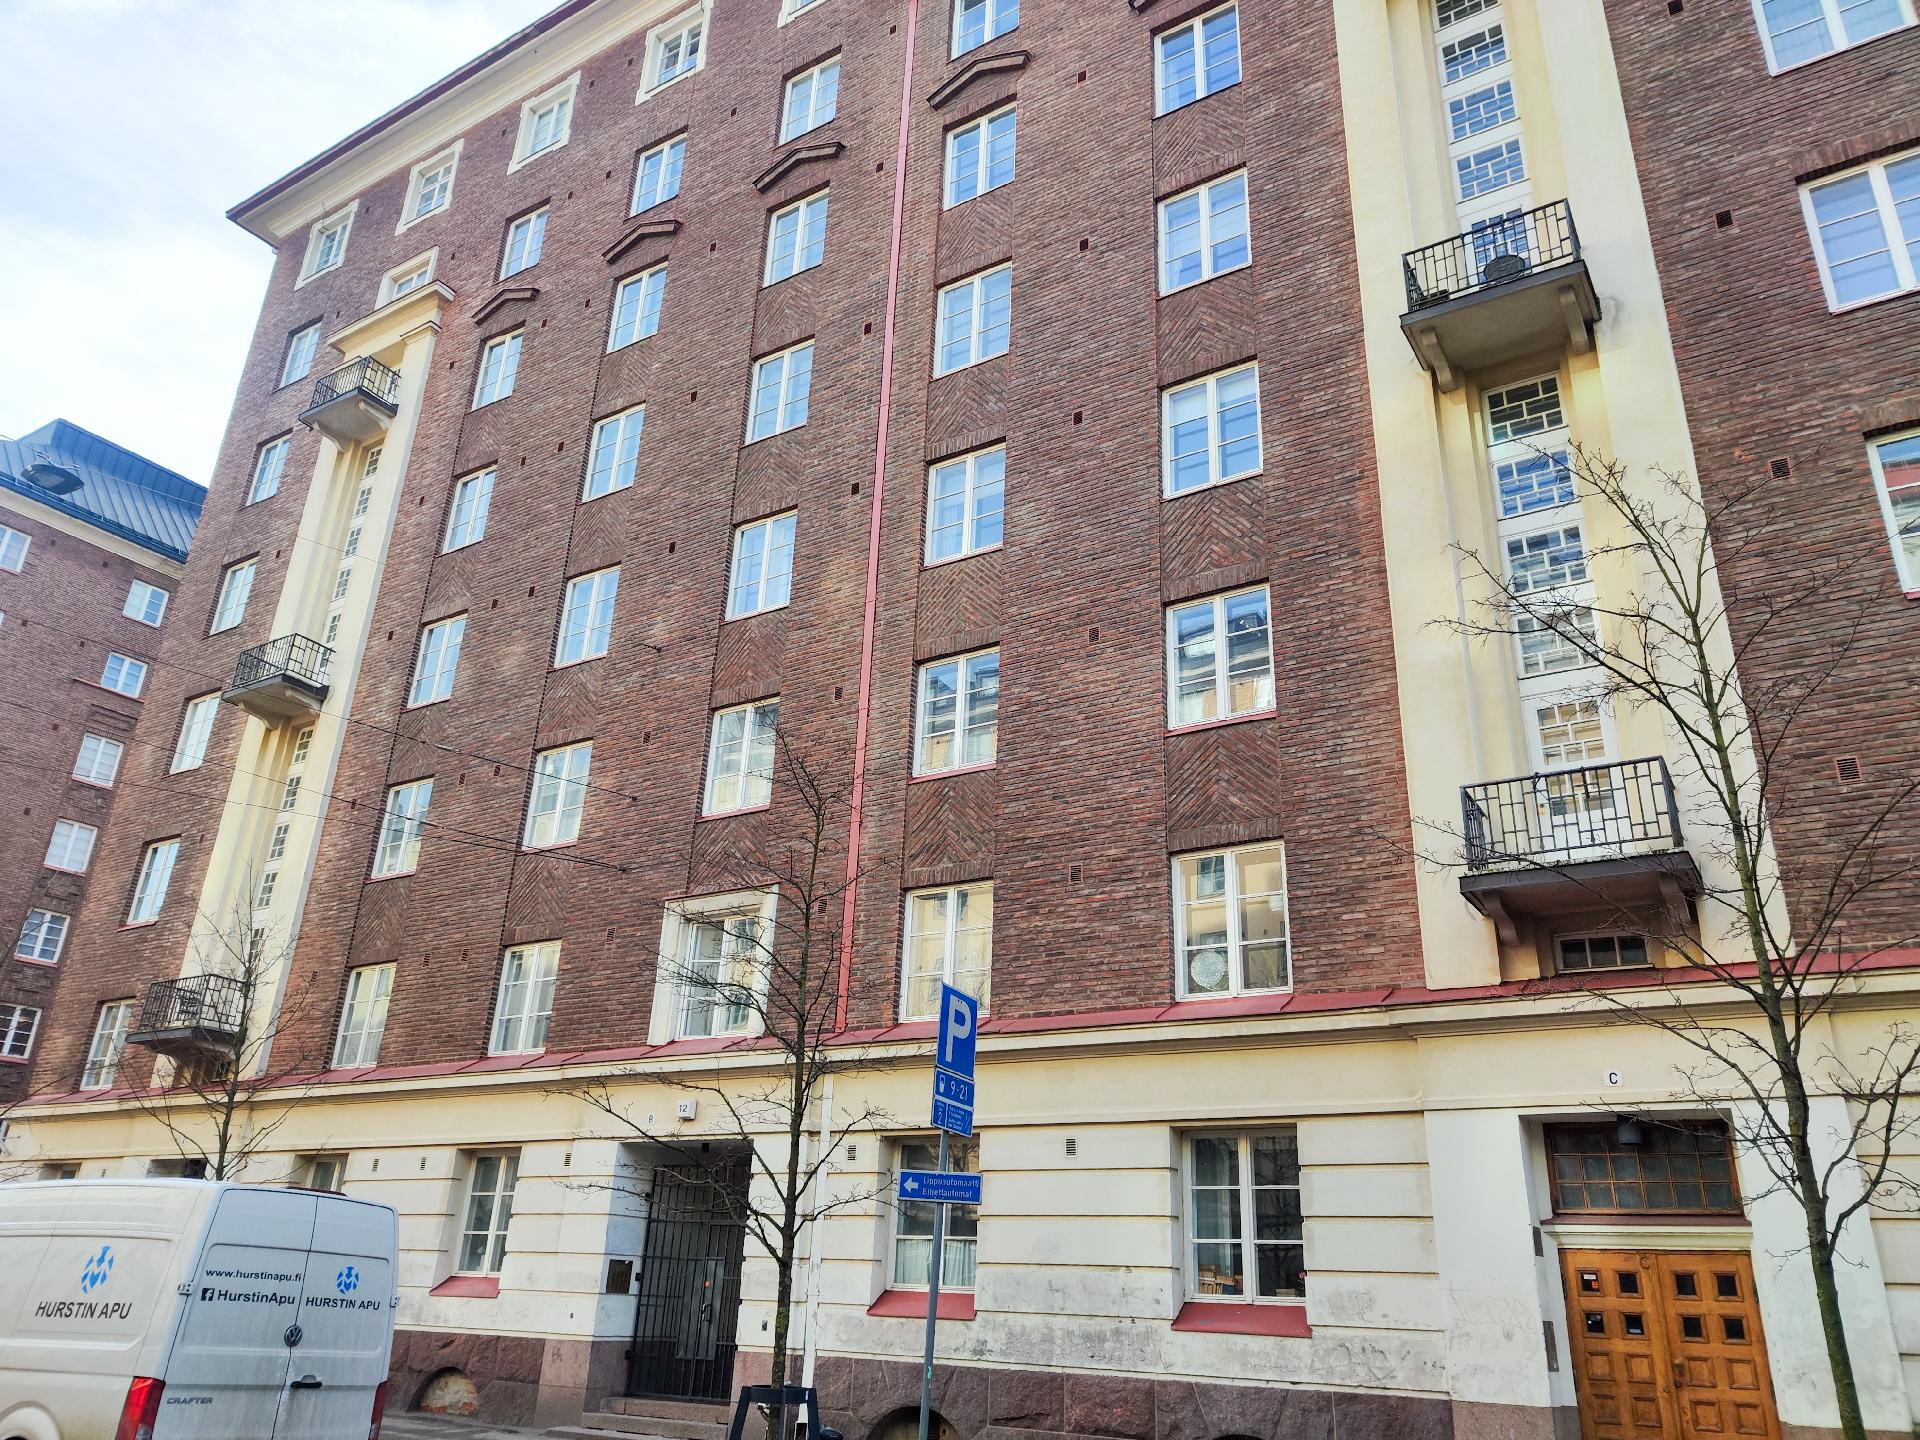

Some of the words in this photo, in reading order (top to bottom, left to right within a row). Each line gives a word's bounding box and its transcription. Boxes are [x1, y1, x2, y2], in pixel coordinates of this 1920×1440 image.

[945, 994, 972, 1063] P
[1609, 1072, 1618, 1085] C
[950, 1080, 968, 1101] 9-21
[679, 1104, 688, 1113] 12
[206, 1268, 302, 1282] www.hurstinapu.fi
[217, 1289, 296, 1307] HurstinApu
[305, 1296, 357, 1310] HURSTIN
[357, 1300, 381, 1311] APU
[34, 1301, 98, 1319] HURSTIN
[97, 1302, 133, 1320] APU
[166, 1396, 213, 1405] CRAFTER
